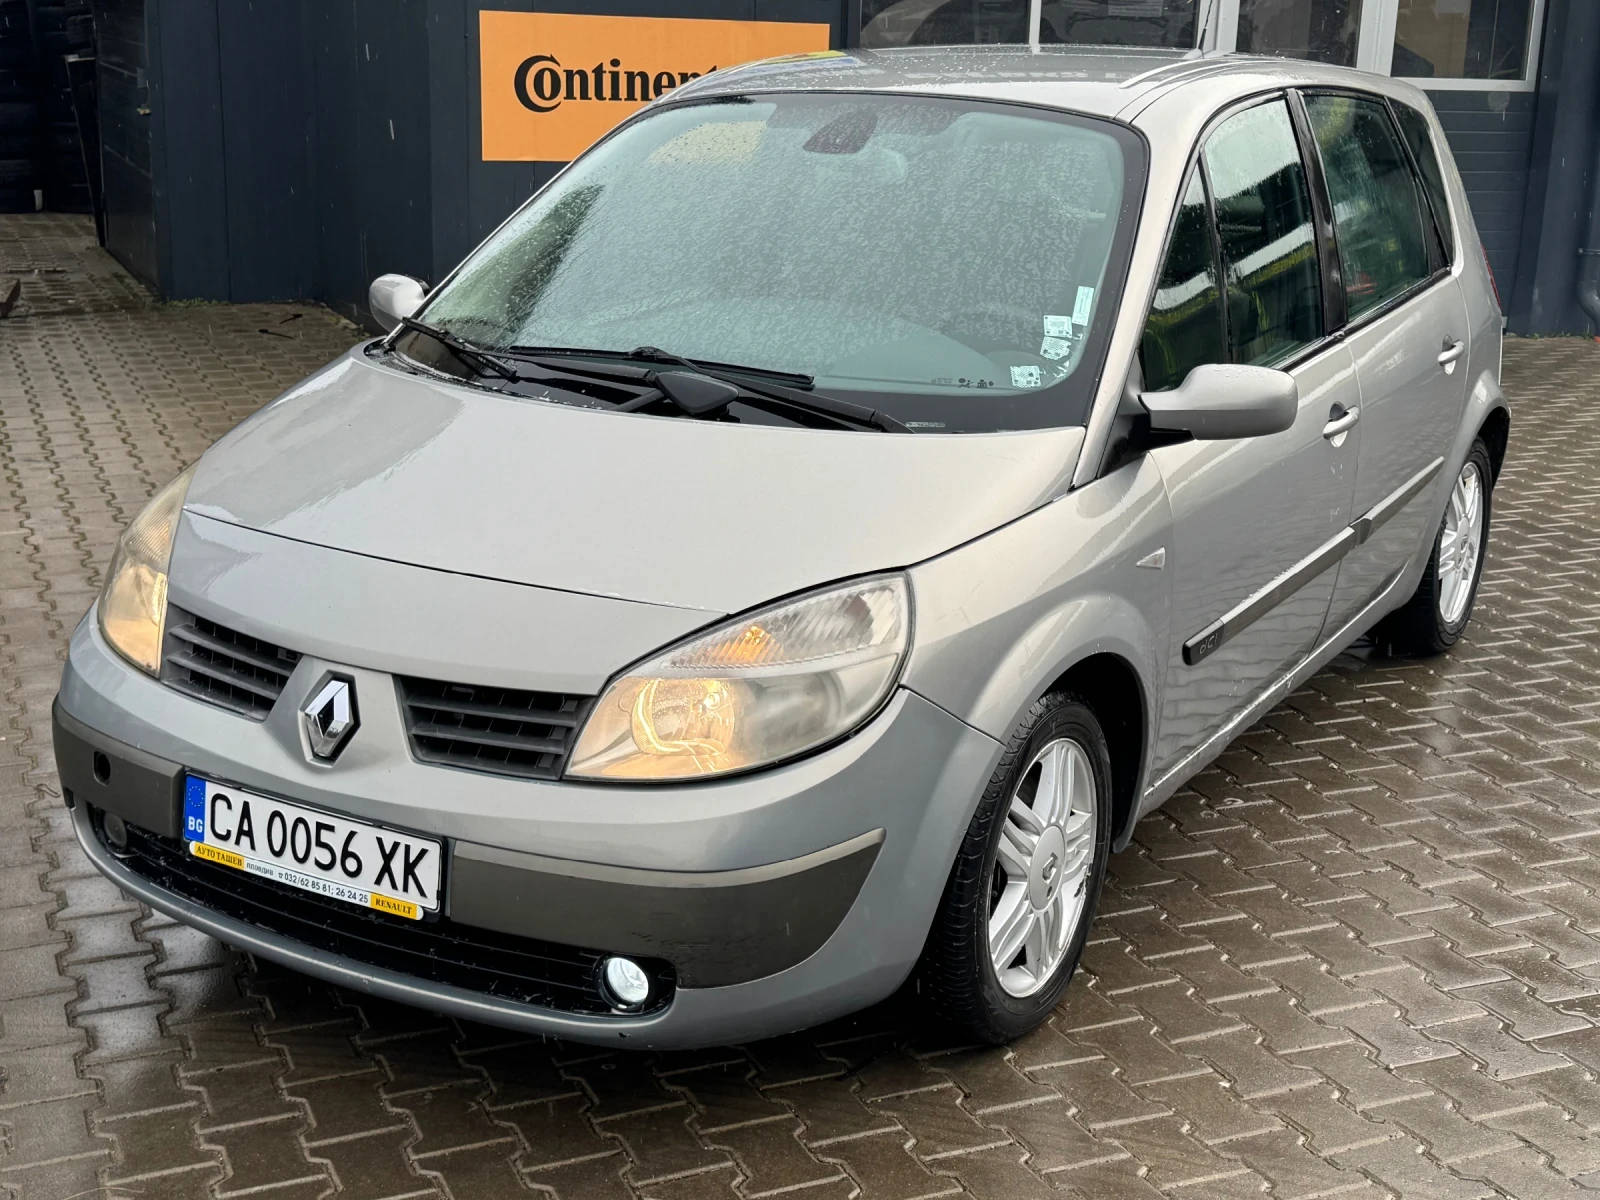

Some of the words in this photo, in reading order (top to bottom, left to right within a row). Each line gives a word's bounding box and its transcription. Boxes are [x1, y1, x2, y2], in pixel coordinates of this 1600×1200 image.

[514, 54, 718, 113] Contine
[187, 816, 204, 834] BG
[211, 793, 256, 851] CA
[267, 810, 363, 877] 0056
[374, 837, 429, 898] XK
[216, 853, 242, 867] ТАШЕВ
[284, 872, 310, 887] 032/62
[311, 880, 321, 891] 85
[335, 887, 346, 897] 26
[347, 890, 357, 901] 24
[358, 893, 369, 904] 25
[376, 898, 412, 914] RENAULT
